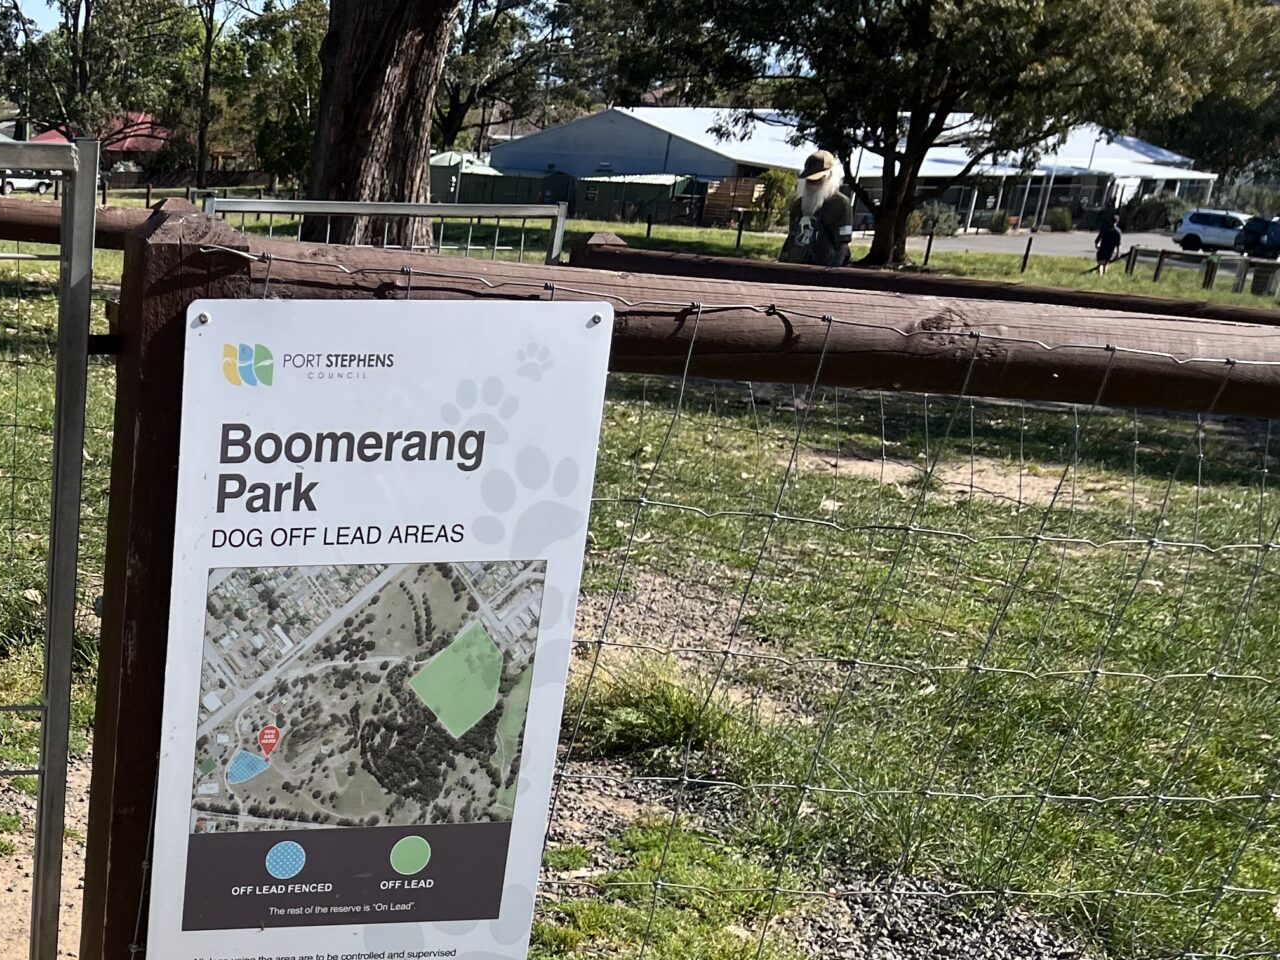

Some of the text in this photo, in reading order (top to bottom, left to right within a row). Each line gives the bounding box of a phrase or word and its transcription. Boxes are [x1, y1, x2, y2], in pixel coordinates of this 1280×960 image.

[283, 353, 394, 368] PORT STEPHENS
[308, 372, 366, 380] COUNCIL
[219, 423, 485, 472] Boomerang
[216, 472, 319, 514] Park
[211, 524, 465, 549] DOG OFF LEAD AREAS
[231, 883, 333, 896] OFF LEAD FENCED
[379, 879, 434, 890] OFF LEAD
[269, 906, 285, 915] The
[286, 906, 303, 915] rest
[304, 905, 314, 914] of
[315, 905, 329, 914] the
[329, 905, 362, 913] reserve
[363, 903, 371, 912] is
[327, 952, 339, 960] be
[340, 951, 385, 960] controlled
[386, 950, 405, 960] and
[407, 948, 457, 960] supervised
